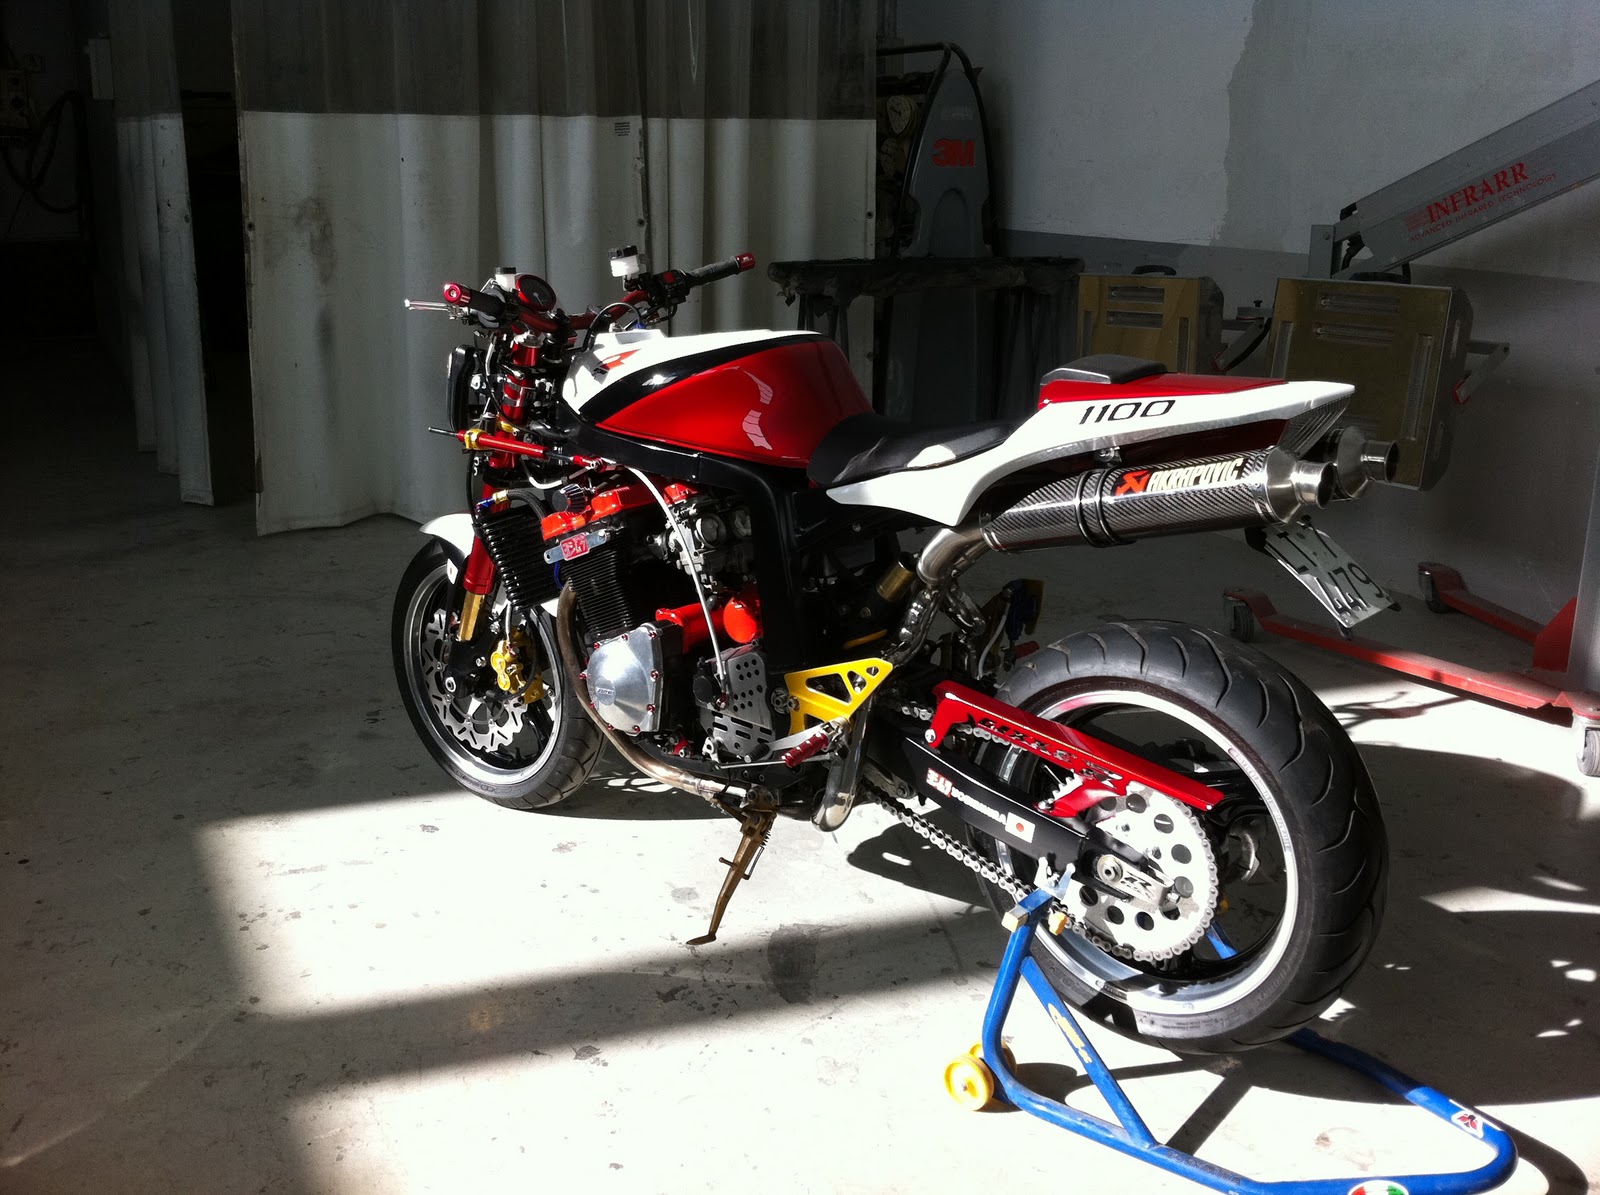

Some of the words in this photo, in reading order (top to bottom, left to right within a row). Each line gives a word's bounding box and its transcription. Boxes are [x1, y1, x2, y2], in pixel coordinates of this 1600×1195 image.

[932, 138, 976, 168] 3M
[1426, 162, 1529, 224] INFRARR
[1079, 399, 1176, 425] 1100
